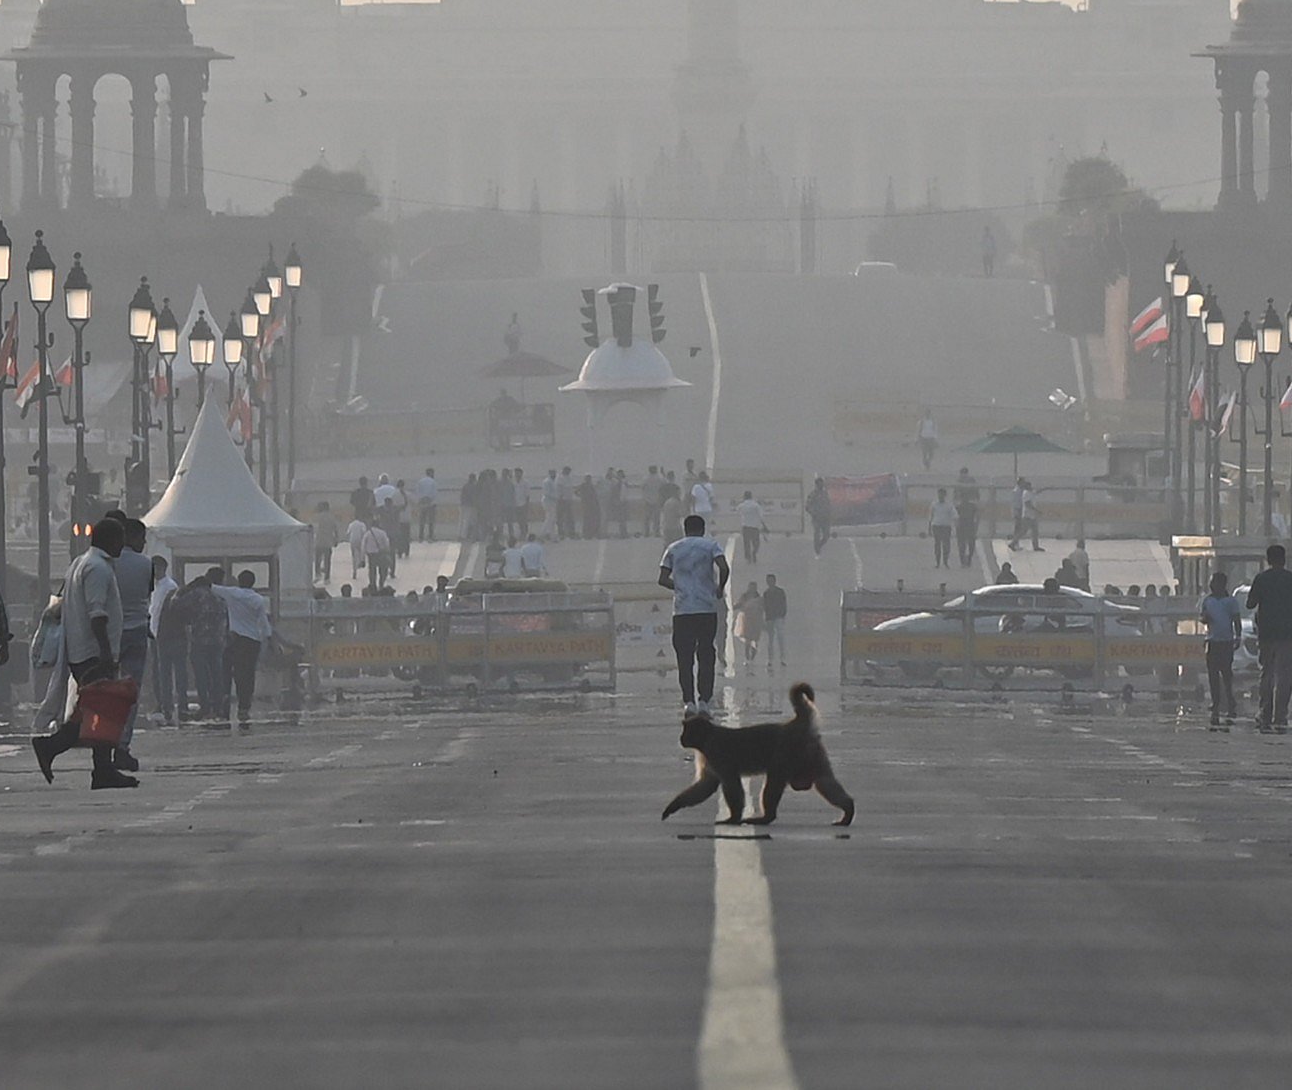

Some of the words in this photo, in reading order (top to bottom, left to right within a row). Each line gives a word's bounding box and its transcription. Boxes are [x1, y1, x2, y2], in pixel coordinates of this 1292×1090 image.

[322, 644, 393, 660] KARTAVYA
[397, 643, 433, 658] PATH
[494, 640, 565, 656] KARTAVYA
[570, 638, 606, 654] PATH
[1109, 643, 1176, 657] KARTAVYA
